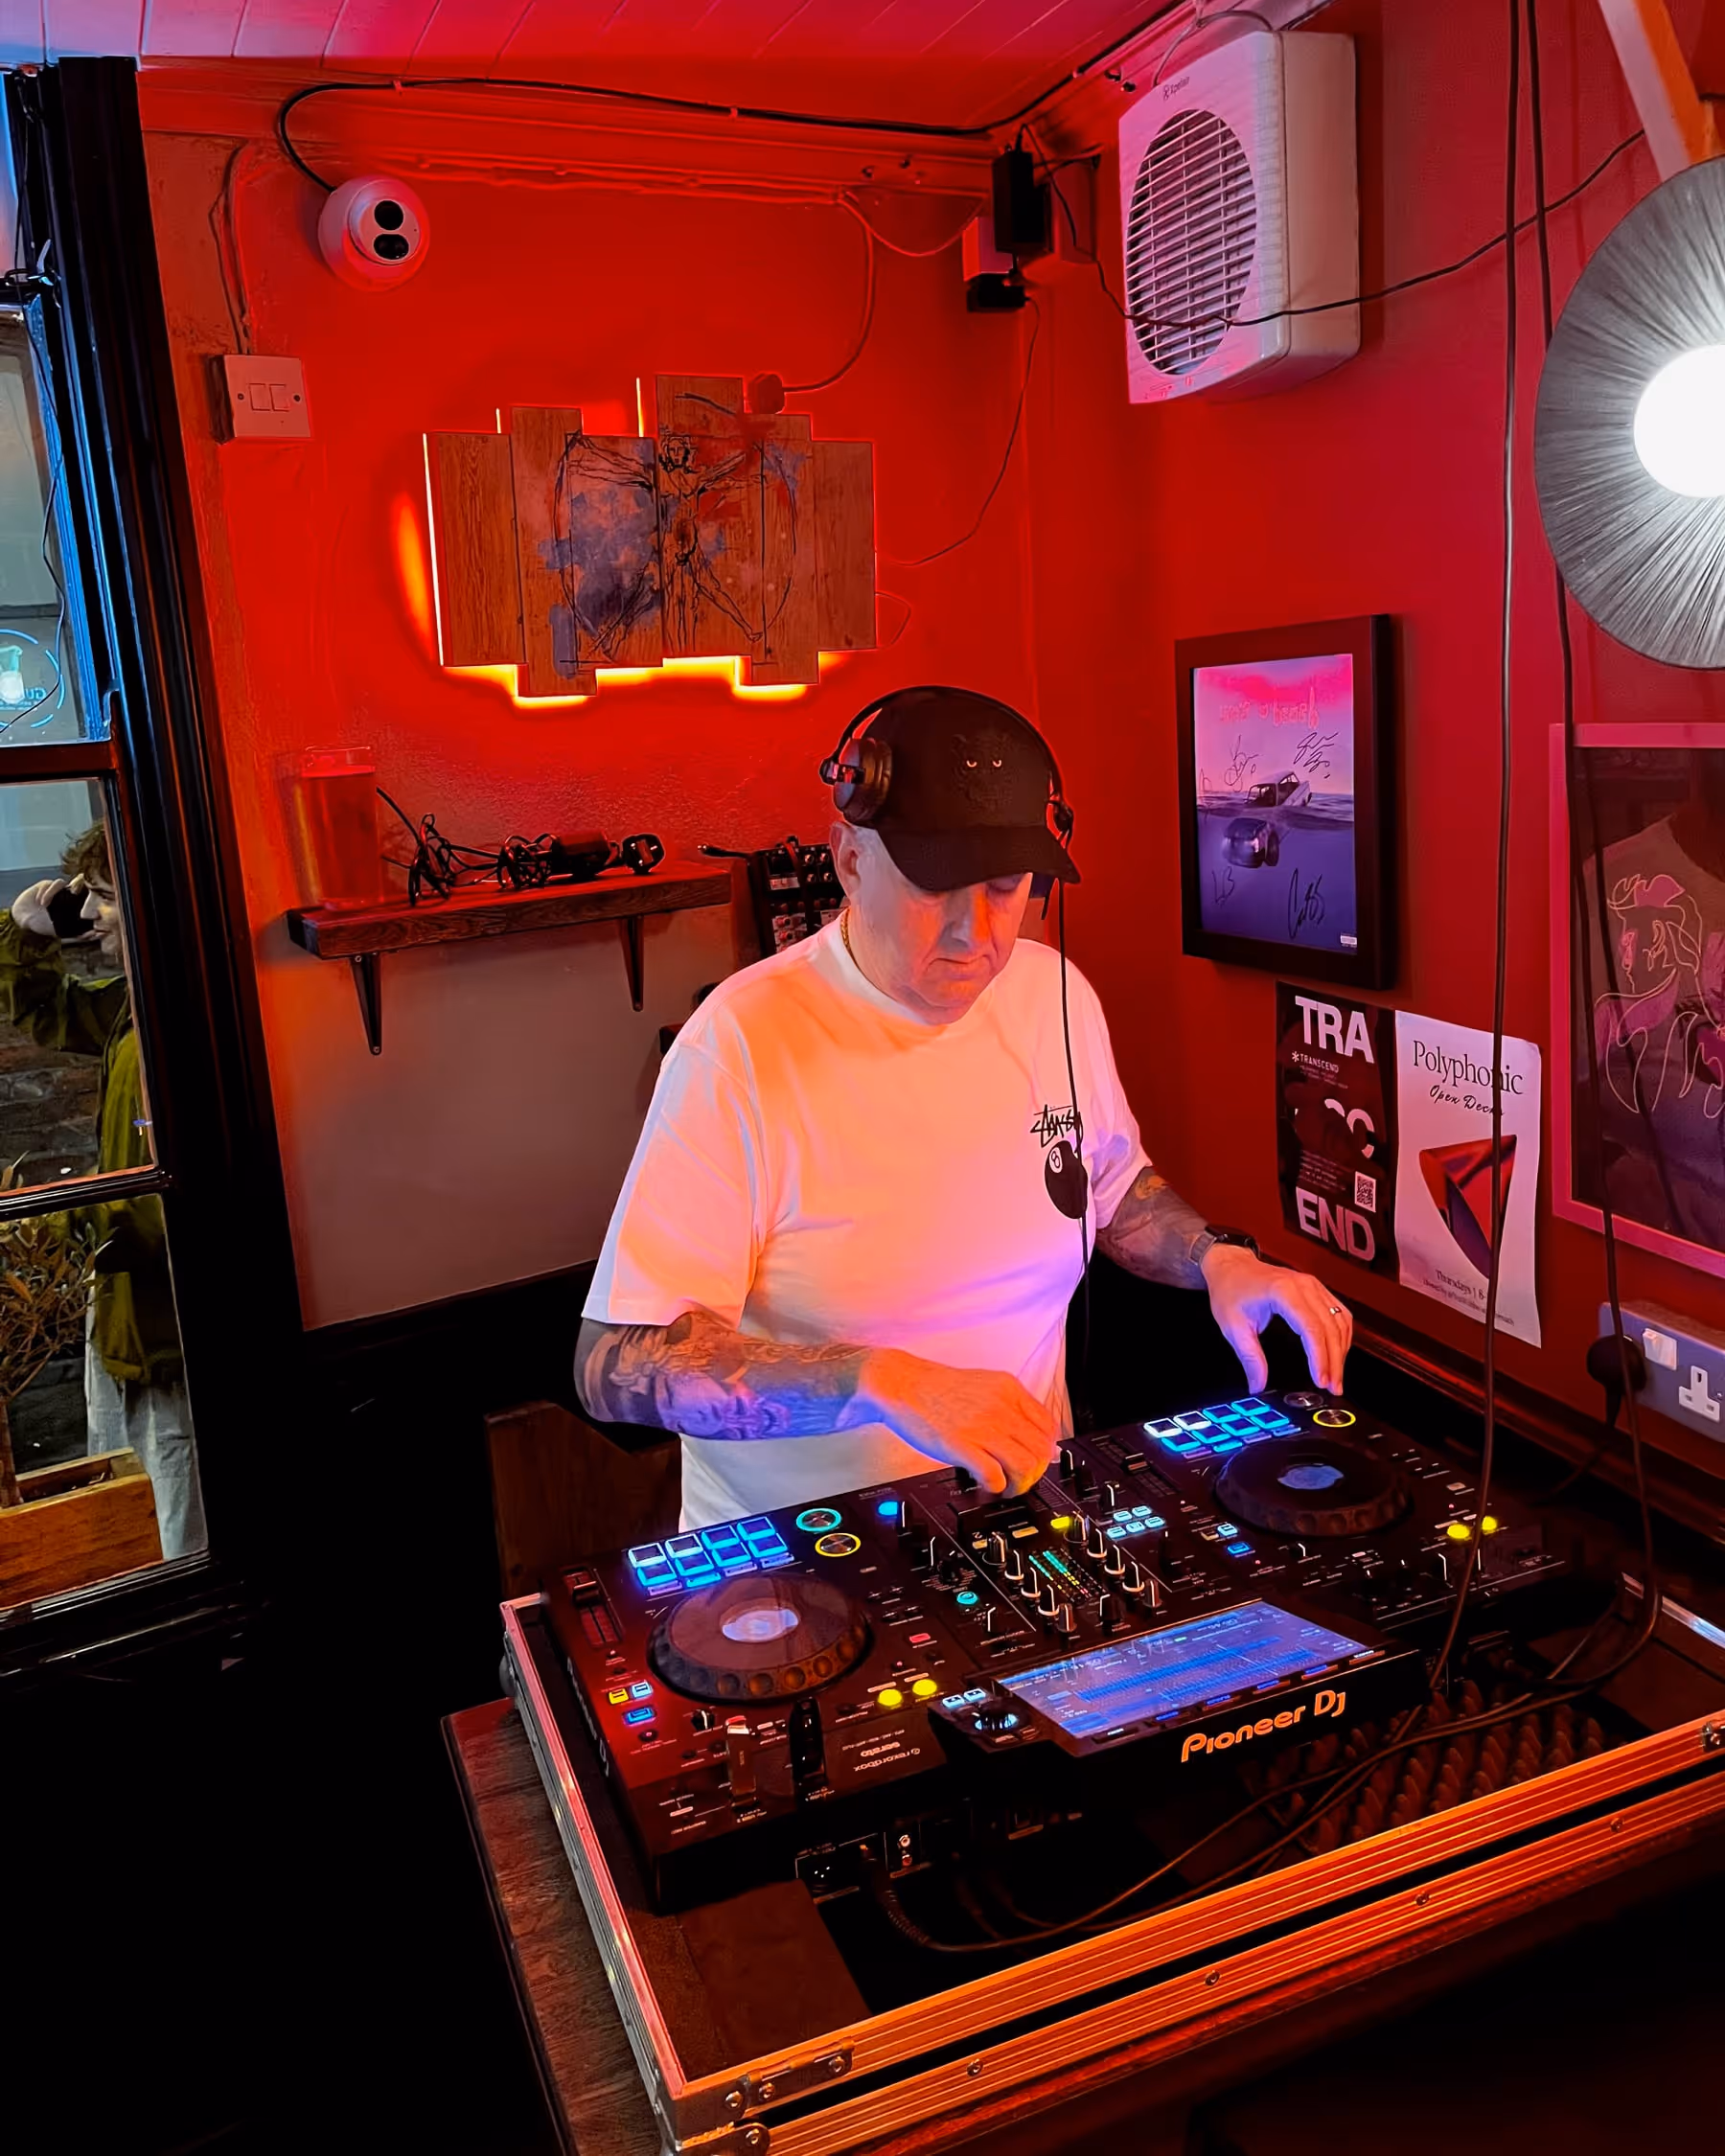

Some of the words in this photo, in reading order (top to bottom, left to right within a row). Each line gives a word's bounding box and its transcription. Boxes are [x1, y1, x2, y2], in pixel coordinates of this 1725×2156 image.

[1295, 995, 1374, 1064] TRA
[1300, 1053, 1340, 1074] TRANSCEND
[1429, 1085, 1460, 1104] Open
[1463, 1094, 1505, 1116] Dec
[1050, 1150, 1061, 1169] 8
[1296, 1186, 1375, 1261] END
[1181, 1705, 1306, 1763] Pioneer
